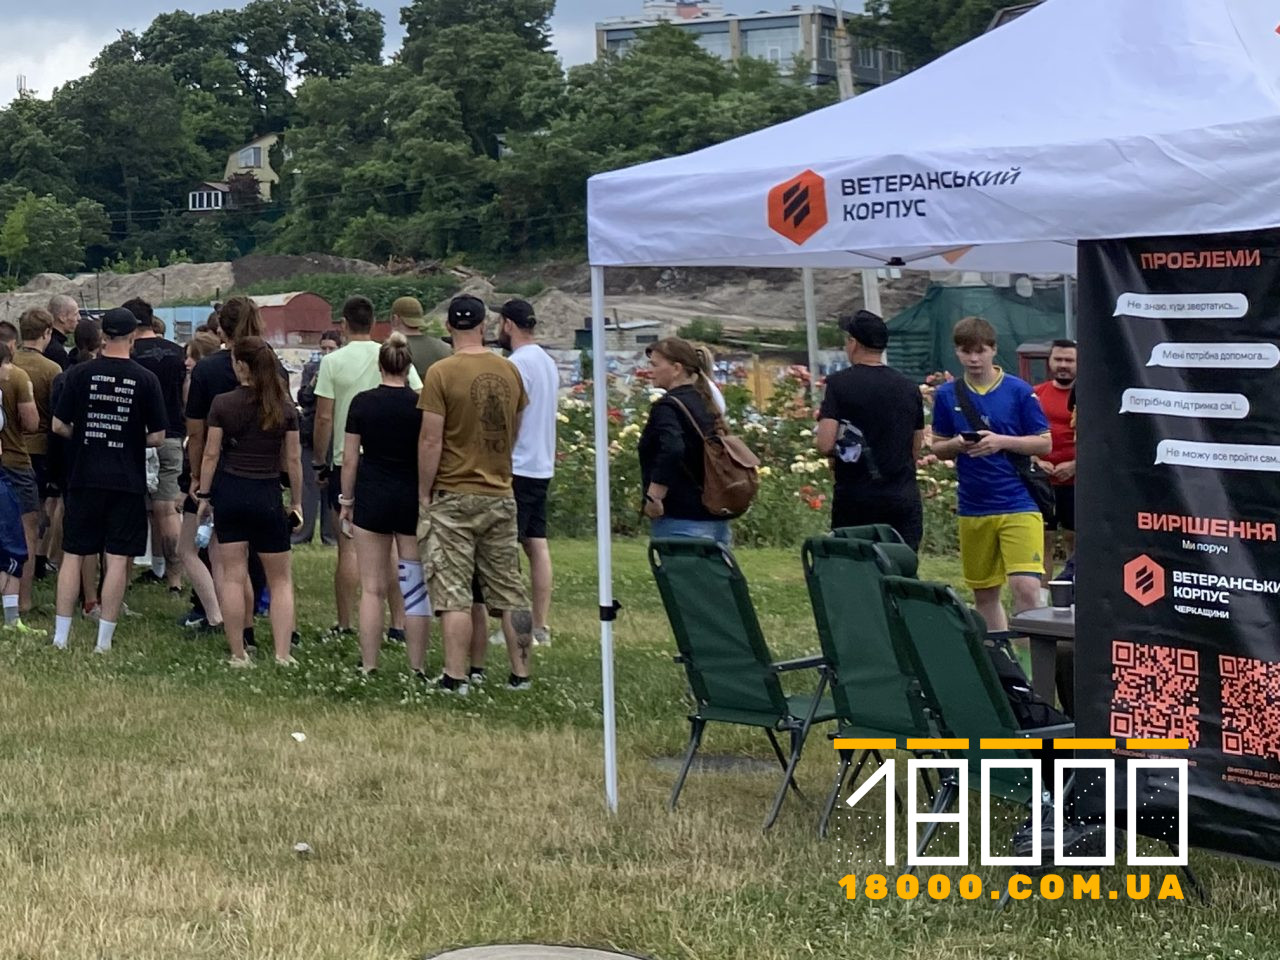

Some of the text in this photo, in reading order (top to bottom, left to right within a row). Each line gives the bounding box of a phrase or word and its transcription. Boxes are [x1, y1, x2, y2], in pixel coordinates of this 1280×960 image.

[840, 166, 1022, 197] ВЕТЕРАНСЬКИЙ
[843, 199, 927, 222] КОРПУС
[1140, 249, 1261, 270] ПРОБЛЕМИ
[1127, 300, 1142, 310] Не
[1162, 349, 1186, 360] Мені
[1185, 350, 1220, 361] потрібна
[1129, 396, 1172, 408] Потрібна
[1173, 400, 1219, 411] підтримка
[1166, 447, 1180, 457] Не
[1181, 451, 1210, 460] можу
[1212, 452, 1228, 461] все
[1228, 452, 1259, 462] пройти
[1137, 511, 1277, 542] ВИРІШЕННЯ
[1182, 539, 1229, 555] Ми поруч
[1173, 586, 1230, 605] КОРПУС
[1174, 604, 1230, 620] ЧЕРКАЩИНИ
